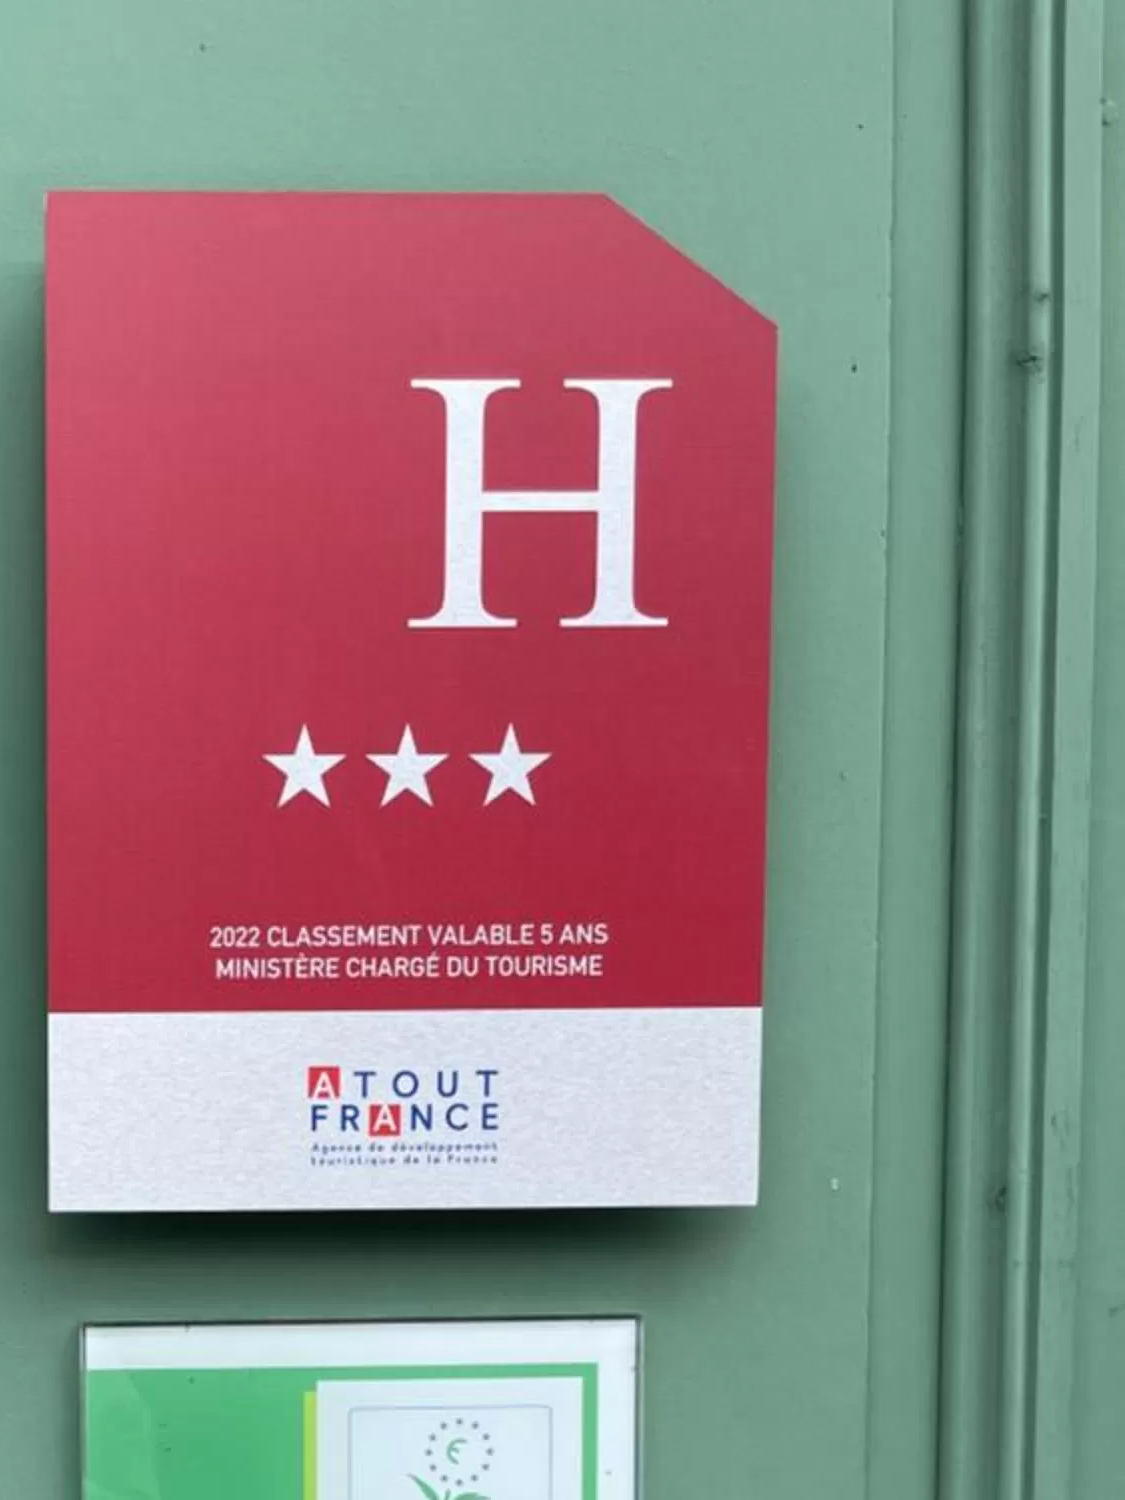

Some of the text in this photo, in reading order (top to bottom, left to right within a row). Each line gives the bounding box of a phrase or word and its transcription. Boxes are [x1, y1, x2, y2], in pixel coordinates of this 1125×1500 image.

[407, 377, 673, 628] H
[209, 923, 609, 948] 2022 CLASSEMENT VALABLE 5 ANS
[215, 952, 604, 978] MINISTÈRE CHARGÉ DU TOURISME
[311, 1103, 499, 1136] FRANCE
[312, 1142, 362, 1155] Agence
[368, 1142, 384, 1152] de
[403, 1155, 420, 1165] de
